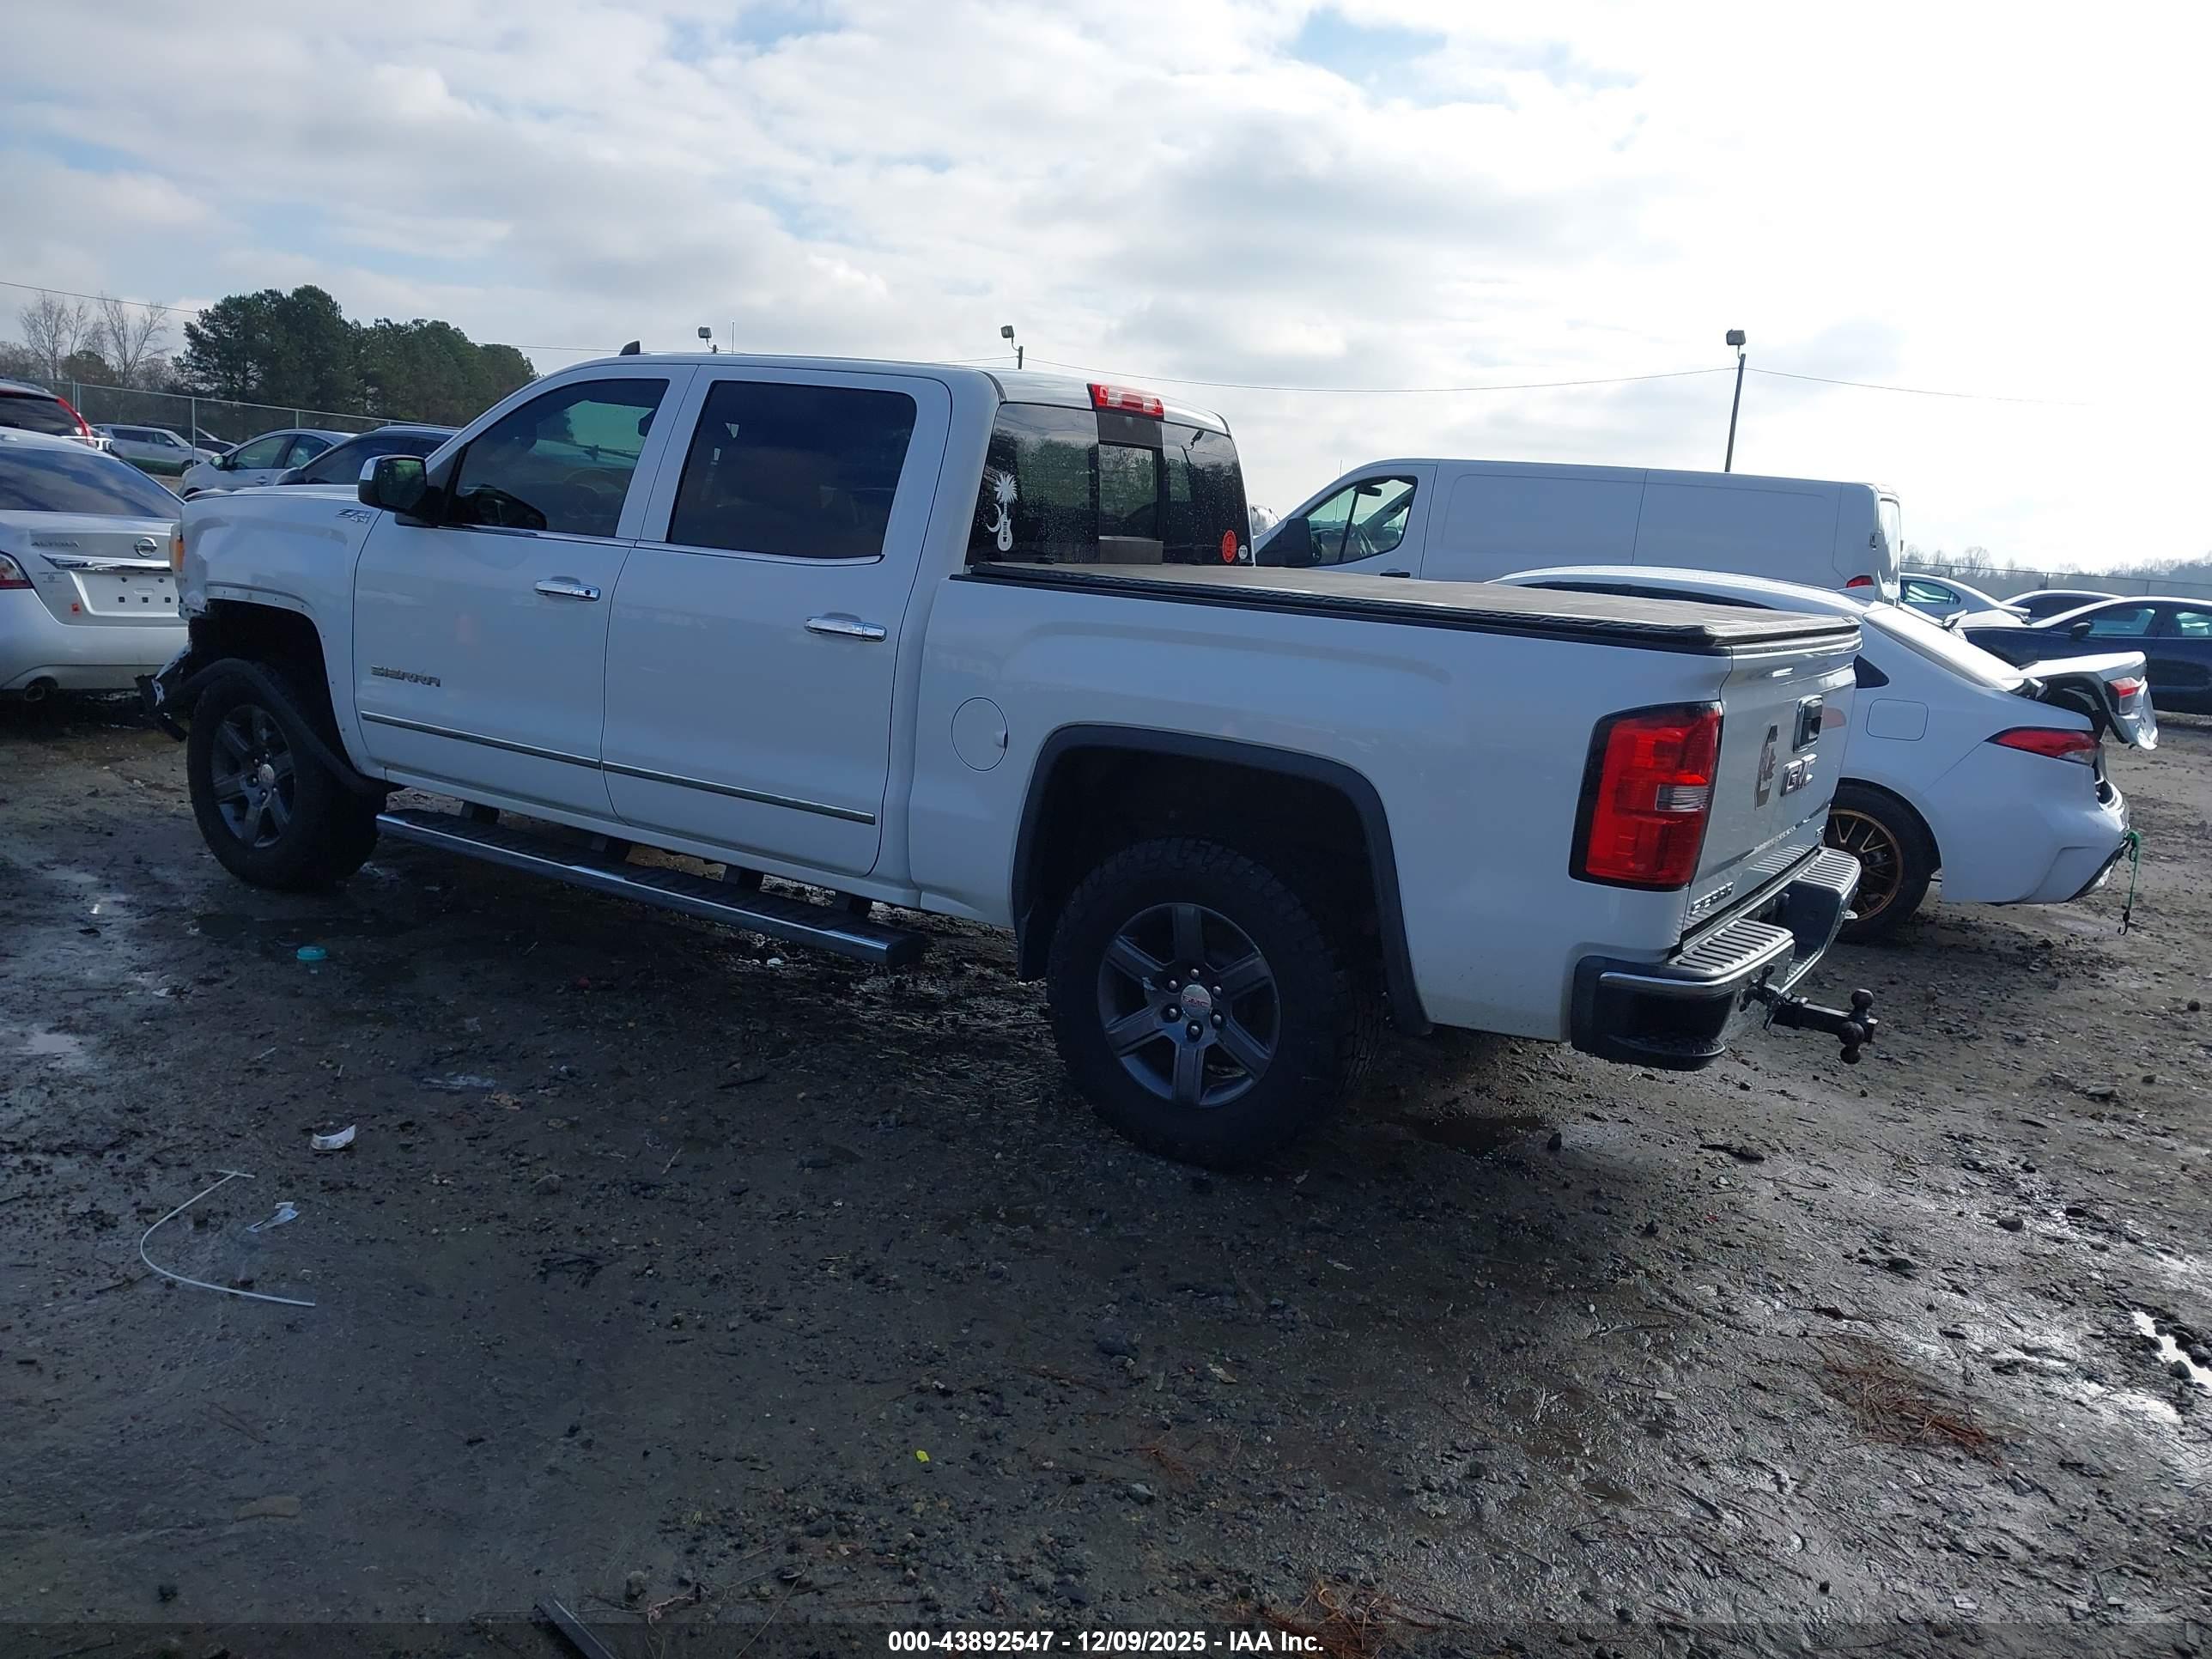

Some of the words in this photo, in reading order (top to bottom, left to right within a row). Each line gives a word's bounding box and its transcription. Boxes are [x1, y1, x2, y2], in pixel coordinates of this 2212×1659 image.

[370, 665, 441, 688] SIERRA
[1780, 753, 1818, 797] GMC
[1182, 995, 1211, 1008] GMC
